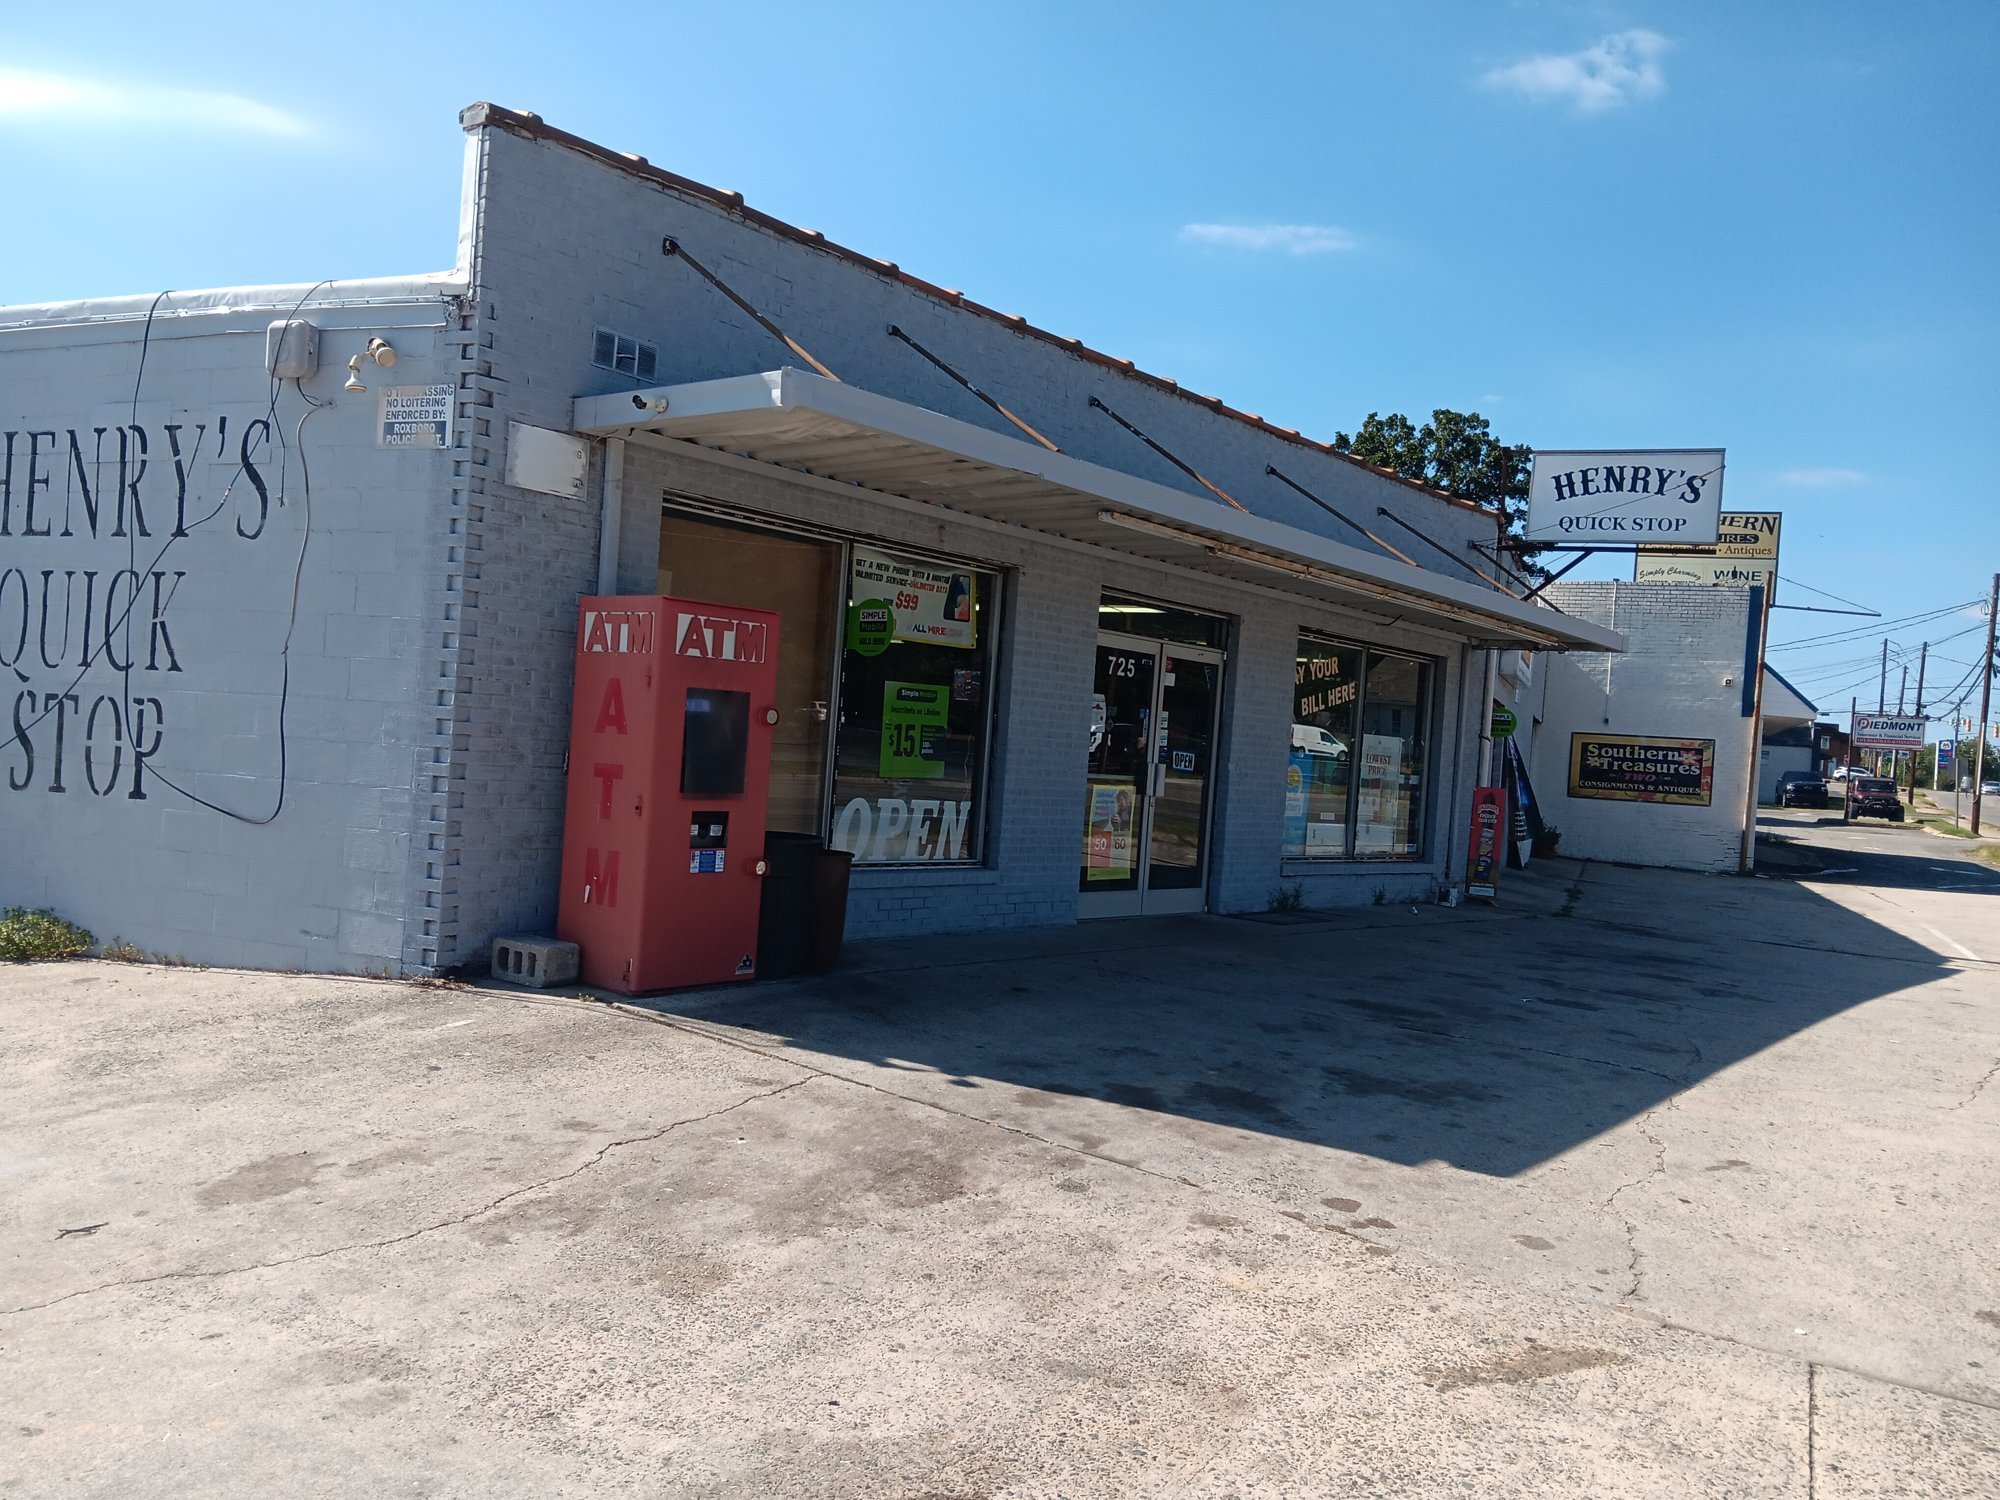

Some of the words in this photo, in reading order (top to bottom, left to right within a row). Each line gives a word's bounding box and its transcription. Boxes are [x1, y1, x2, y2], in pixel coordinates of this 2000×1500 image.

[387, 398, 398, 408] NO
[401, 397, 446, 408] LOITERING
[386, 410, 430, 420] ENFORCED
[433, 409, 446, 419] BY:
[394, 423, 436, 434] ROXBORO
[1551, 465, 1708, 504] HENRY'S
[1559, 516, 1627, 533] QUICK
[1631, 517, 1687, 532] STOP
[1724, 545, 1773, 557] Antiques
[868, 561, 873, 569] A
[875, 561, 891, 572] NEW
[1639, 568, 1665, 580] Simply
[1667, 567, 1701, 580] Charming
[1714, 567, 1762, 581] WINE
[896, 590, 919, 611] $99
[861, 611, 887, 620] SIMPLE
[0, 568, 186, 683] QUICK
[586, 613, 652, 652] ATM
[912, 623, 927, 633] ALL
[678, 614, 765, 662] ATM
[1108, 656, 1136, 678] 725
[1309, 656, 1339, 680] YOUR
[901, 689, 919, 698] Simple
[1301, 692, 1325, 717] BILL
[1328, 682, 1356, 707] HERE
[1857, 717, 1924, 732] PIEDMONT
[9, 690, 164, 799] STOP
[1587, 744, 1680, 761] Southern
[1174, 752, 1194, 769] OPEN
[1366, 753, 1392, 765] LOWEST
[1600, 758, 1701, 776] Treasures
[1624, 773, 1657, 782] TWO
[1579, 780, 1645, 791] CONSIGNMENTS
[1657, 784, 1701, 794] ANTIQUES
[834, 797, 972, 861] OPEN
